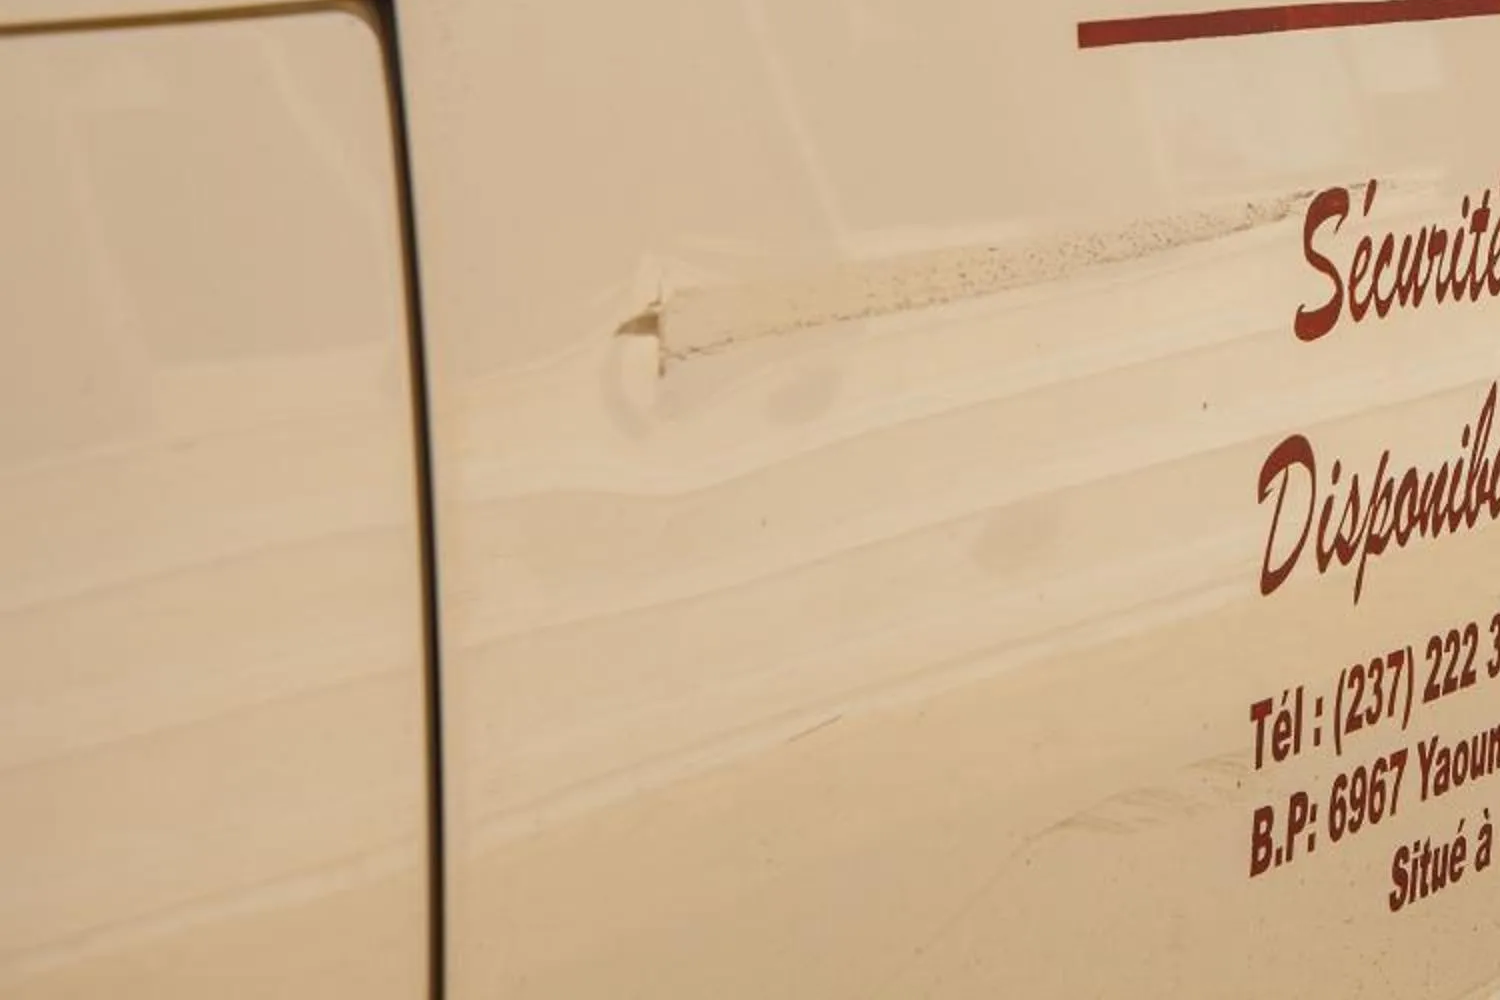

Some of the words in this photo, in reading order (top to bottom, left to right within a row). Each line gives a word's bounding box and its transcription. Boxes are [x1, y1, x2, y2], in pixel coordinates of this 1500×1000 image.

[1250, 685, 1304, 771] Tél
[1333, 645, 1415, 757] (237)
[1422, 621, 1479, 704] 222
[1328, 747, 1409, 843] 6967
[1388, 817, 1467, 913] Situé
[1473, 807, 1493, 873] à
